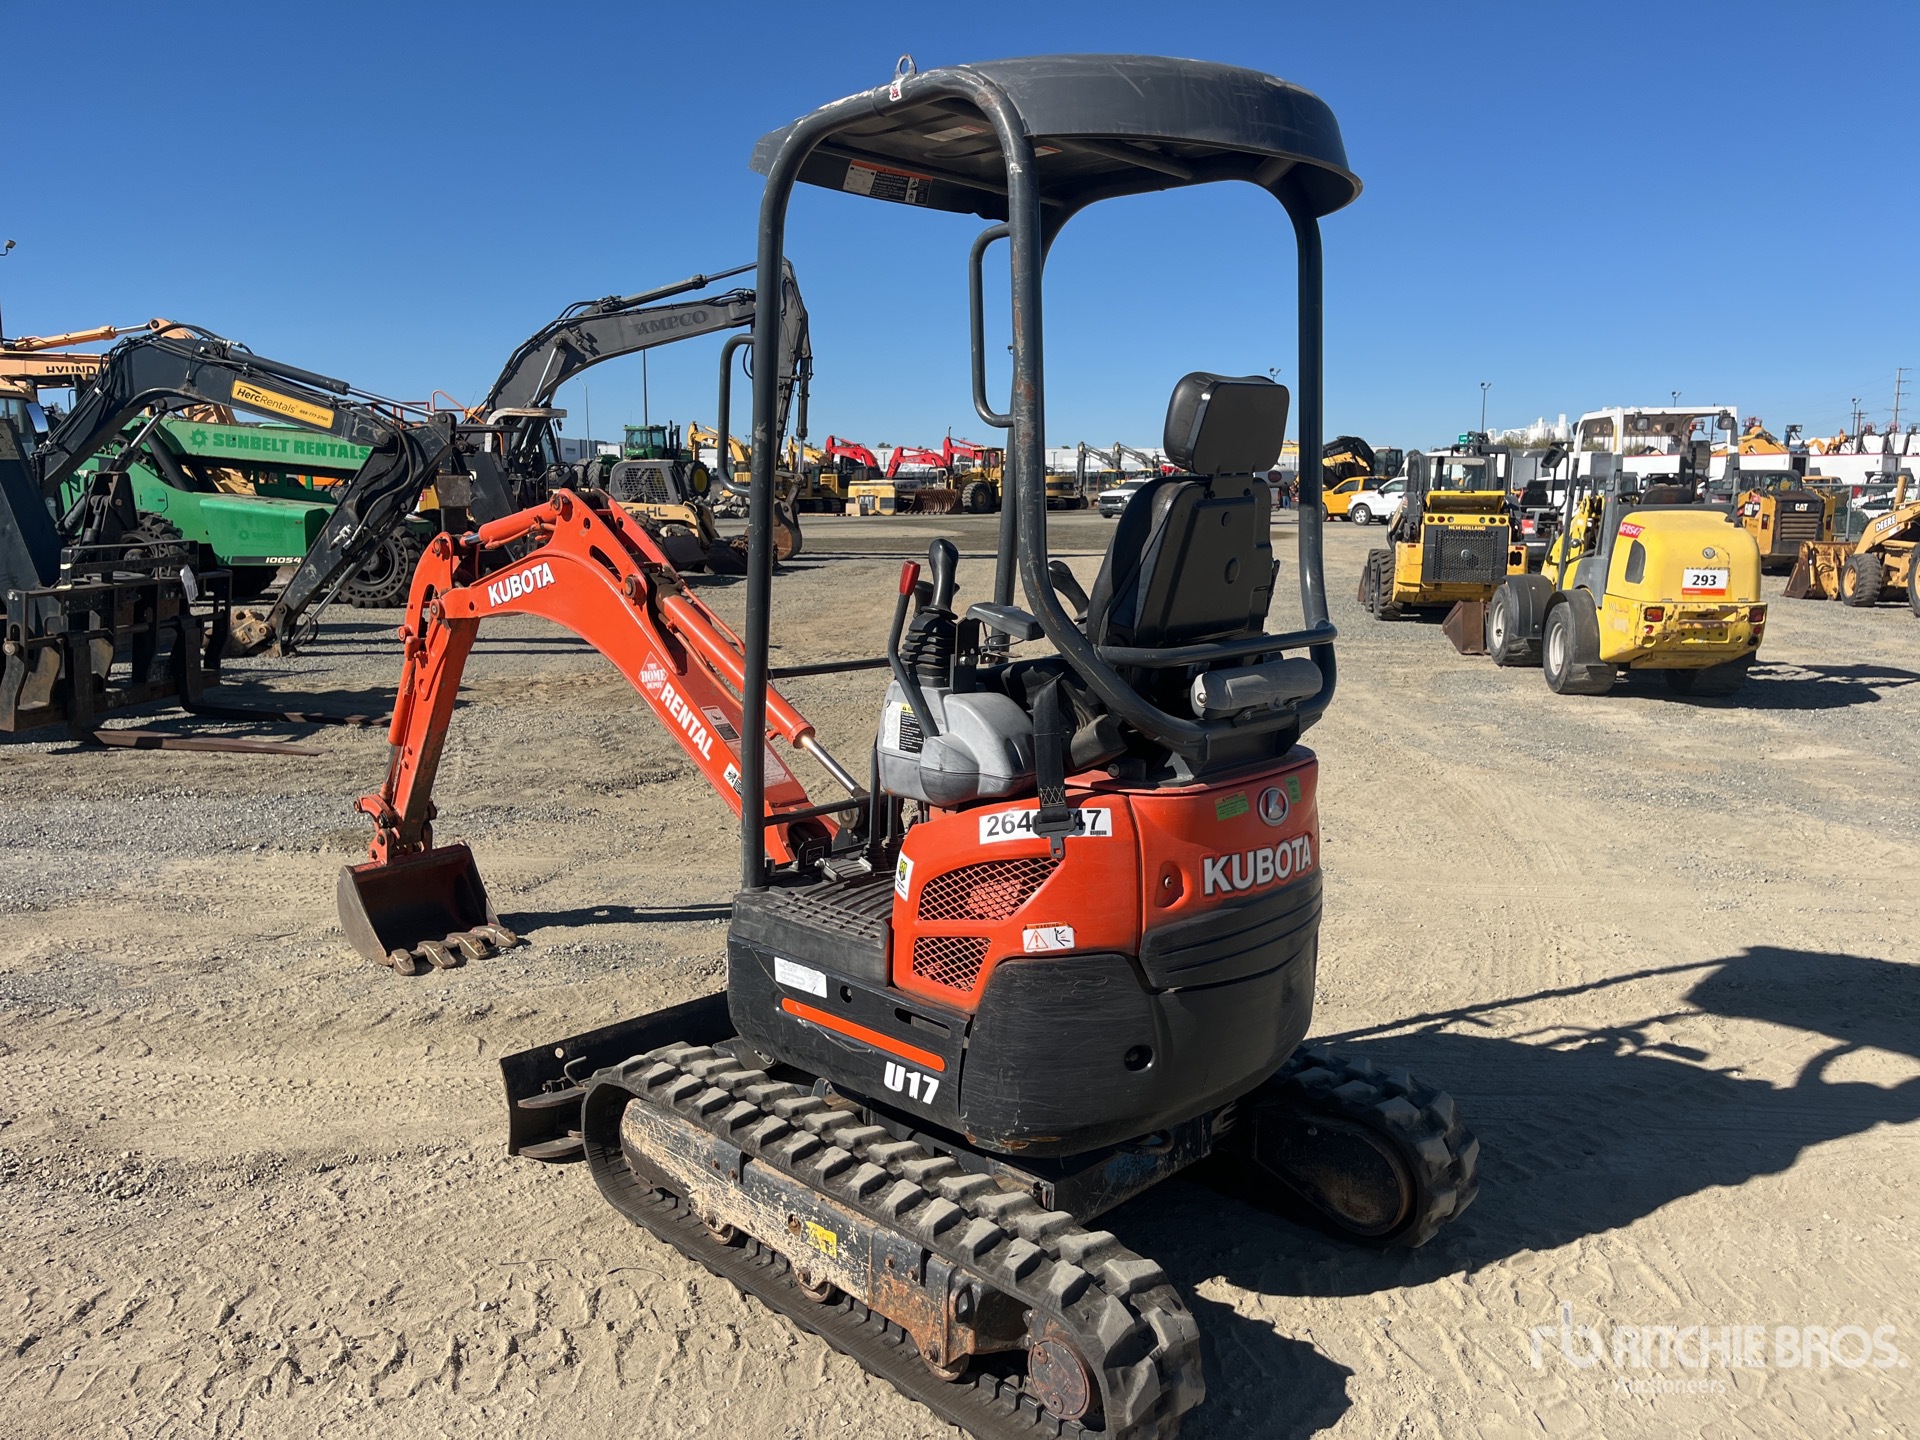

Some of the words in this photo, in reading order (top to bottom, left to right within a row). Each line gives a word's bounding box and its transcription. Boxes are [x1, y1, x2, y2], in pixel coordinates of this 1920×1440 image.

[46, 365, 100, 374] HYUND
[236, 388, 296, 414] HercRentals
[212, 432, 290, 453] SUNBELT
[293, 439, 372, 460] RENTALS
[1795, 503, 1808, 512] CAT
[1875, 514, 1896, 533] DEERE
[487, 562, 556, 607] KUBOTA
[1692, 575, 1717, 586] 293
[641, 669, 666, 682] HOME
[646, 681, 663, 690] DEPOT
[660, 682, 713, 761] RENTAL
[1203, 834, 1312, 895] KUBOTA
[883, 1061, 940, 1105] U17
